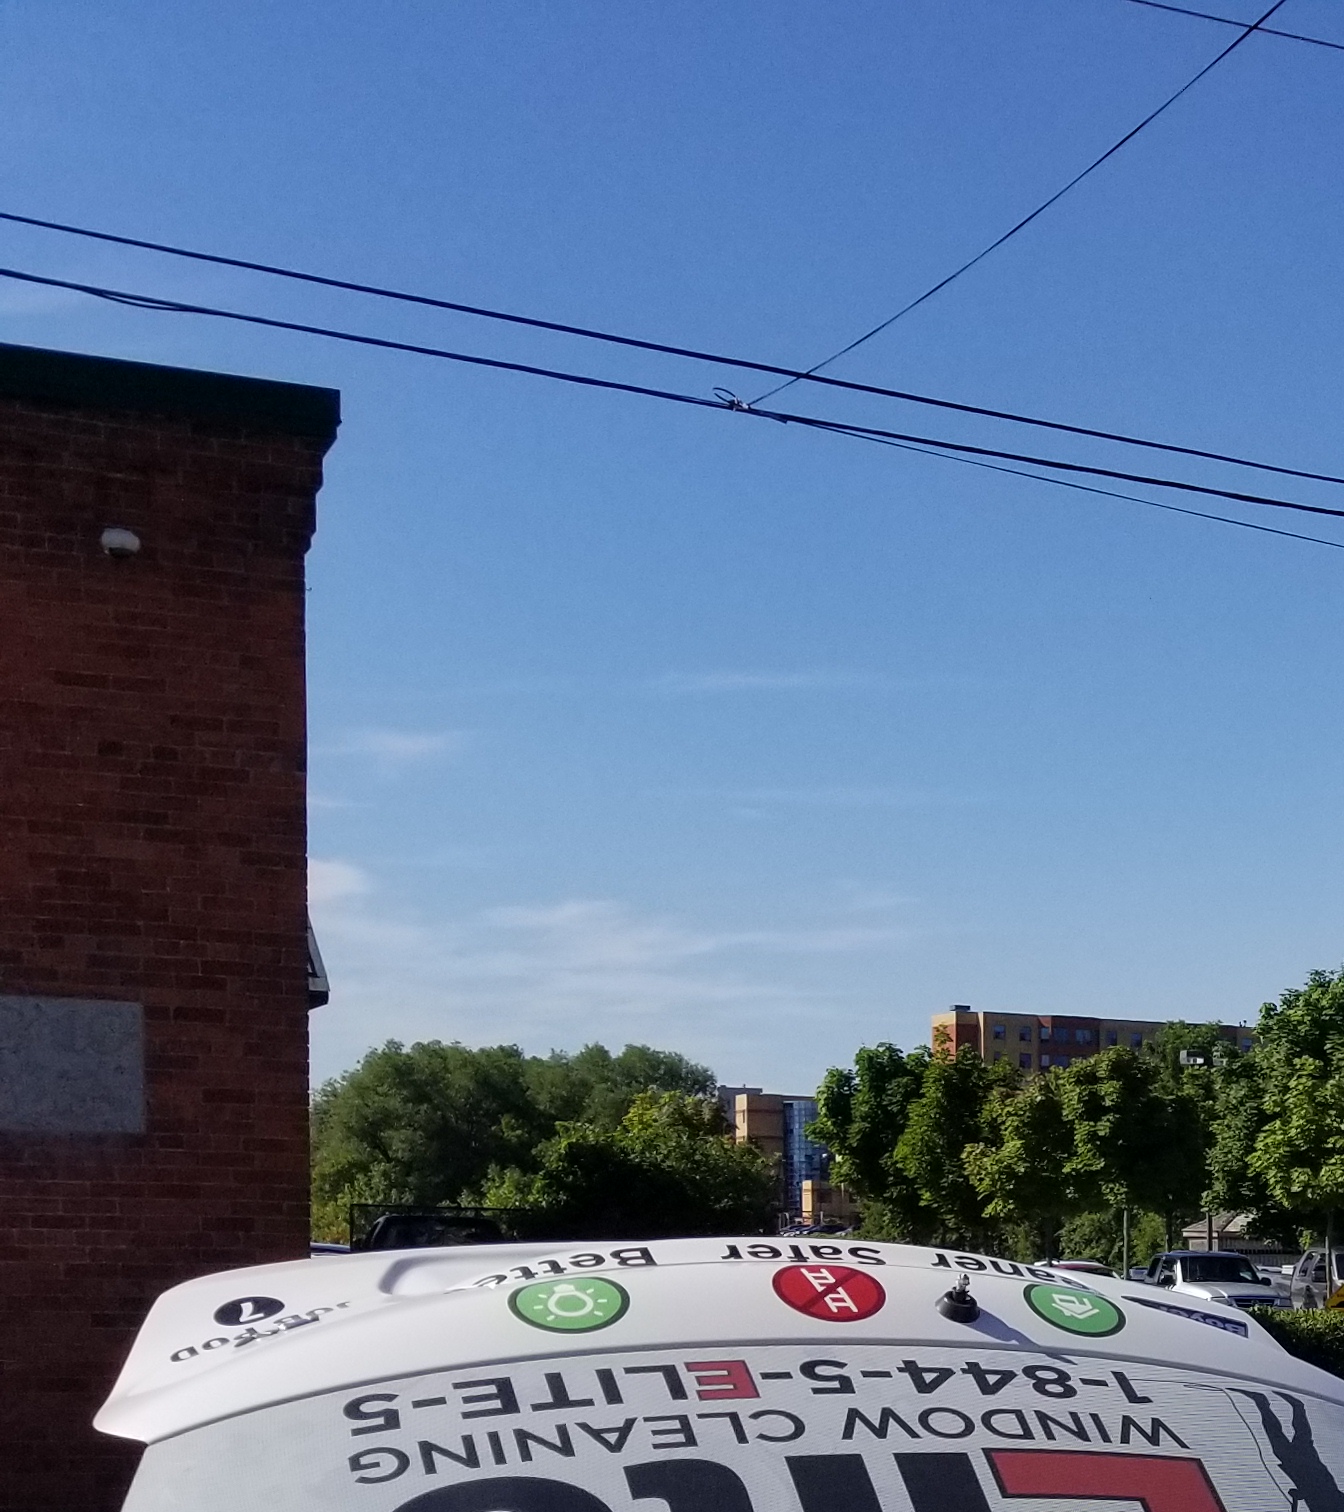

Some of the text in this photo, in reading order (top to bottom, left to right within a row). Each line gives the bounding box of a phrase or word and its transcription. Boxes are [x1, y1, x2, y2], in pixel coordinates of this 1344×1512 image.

[472, 1246, 658, 1289] Bette
[720, 1243, 887, 1266] Safer
[238, 1301, 265, 1324] 7
[342, 1358, 1154, 1438] 1-844-5-ELITE-5
[347, 1406, 1191, 1485] WINDOW CLEANING
